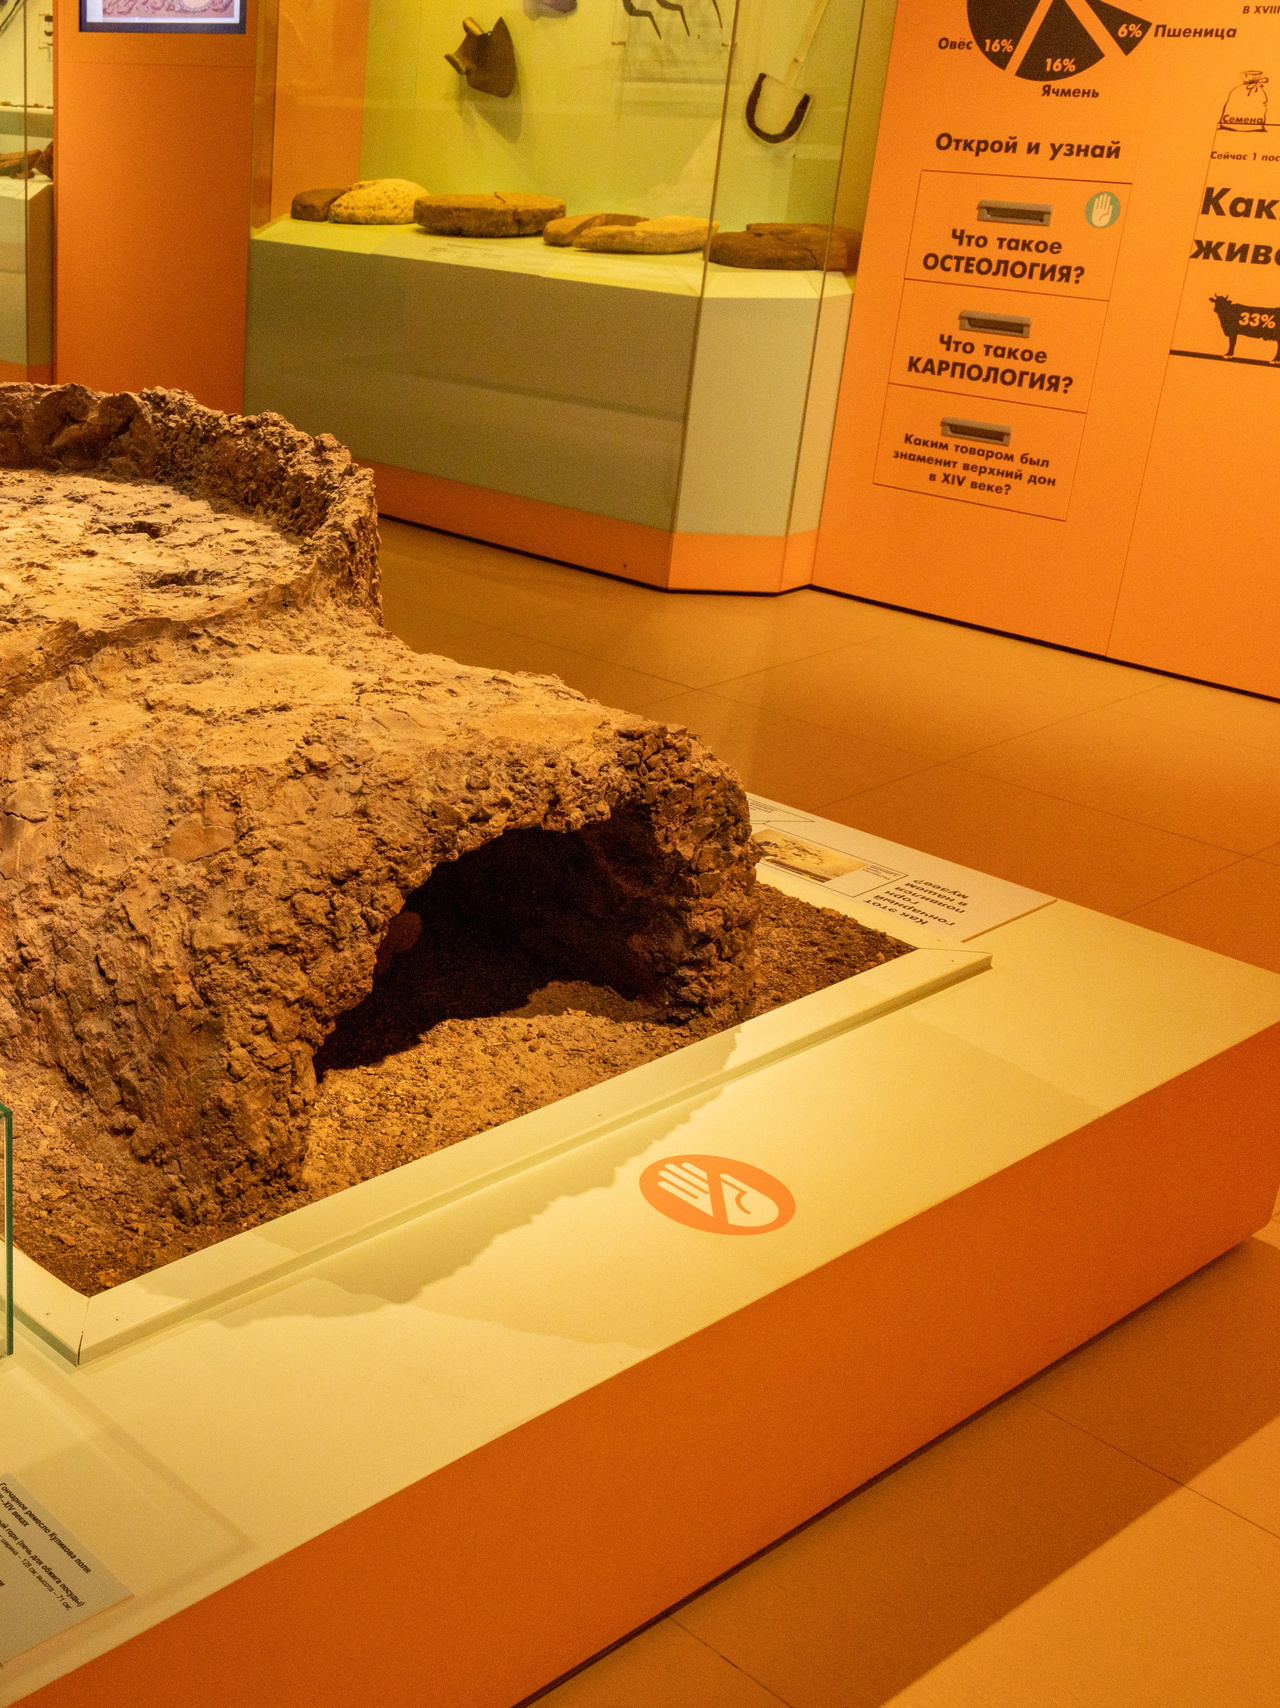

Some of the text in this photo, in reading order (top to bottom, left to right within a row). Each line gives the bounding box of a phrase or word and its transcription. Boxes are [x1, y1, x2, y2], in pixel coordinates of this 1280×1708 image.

[1117, 23, 1142, 38] 6%
[1154, 24, 1237, 40] Пшеница
[938, 37, 973, 50] Овёс
[984, 39, 1014, 53] 16%
[1045, 58, 1076, 72] 16%
[1041, 84, 1099, 98] Ячмень
[1222, 114, 1264, 125] Семена
[935, 132, 1122, 161] Открой и узнай
[1210, 151, 1248, 161] Сейчас
[1253, 153, 1257, 161] 1
[1201, 187, 1280, 220] Как
[951, 228, 1063, 255] Что такое
[1189, 239, 1280, 267] жив
[922, 252, 1086, 284] ОСТЕОЛОГИЯ?
[1238, 312, 1276, 329] 33%
[939, 333, 1048, 364] Что такое
[907, 356, 1074, 394] КАРПОЛОГИЯ?
[904, 433, 1049, 468] Каким товаром был
[892, 450, 1057, 486] знаменит верхний дон
[929, 472, 1012, 495] в XIV веке?
[884, 891, 919, 904] горн
[894, 887, 965, 913] появился
[905, 882, 955, 901] нашем
[913, 879, 969, 899] музее?
[863, 899, 928, 925] Как этот
[873, 895, 955, 926] гончарный
